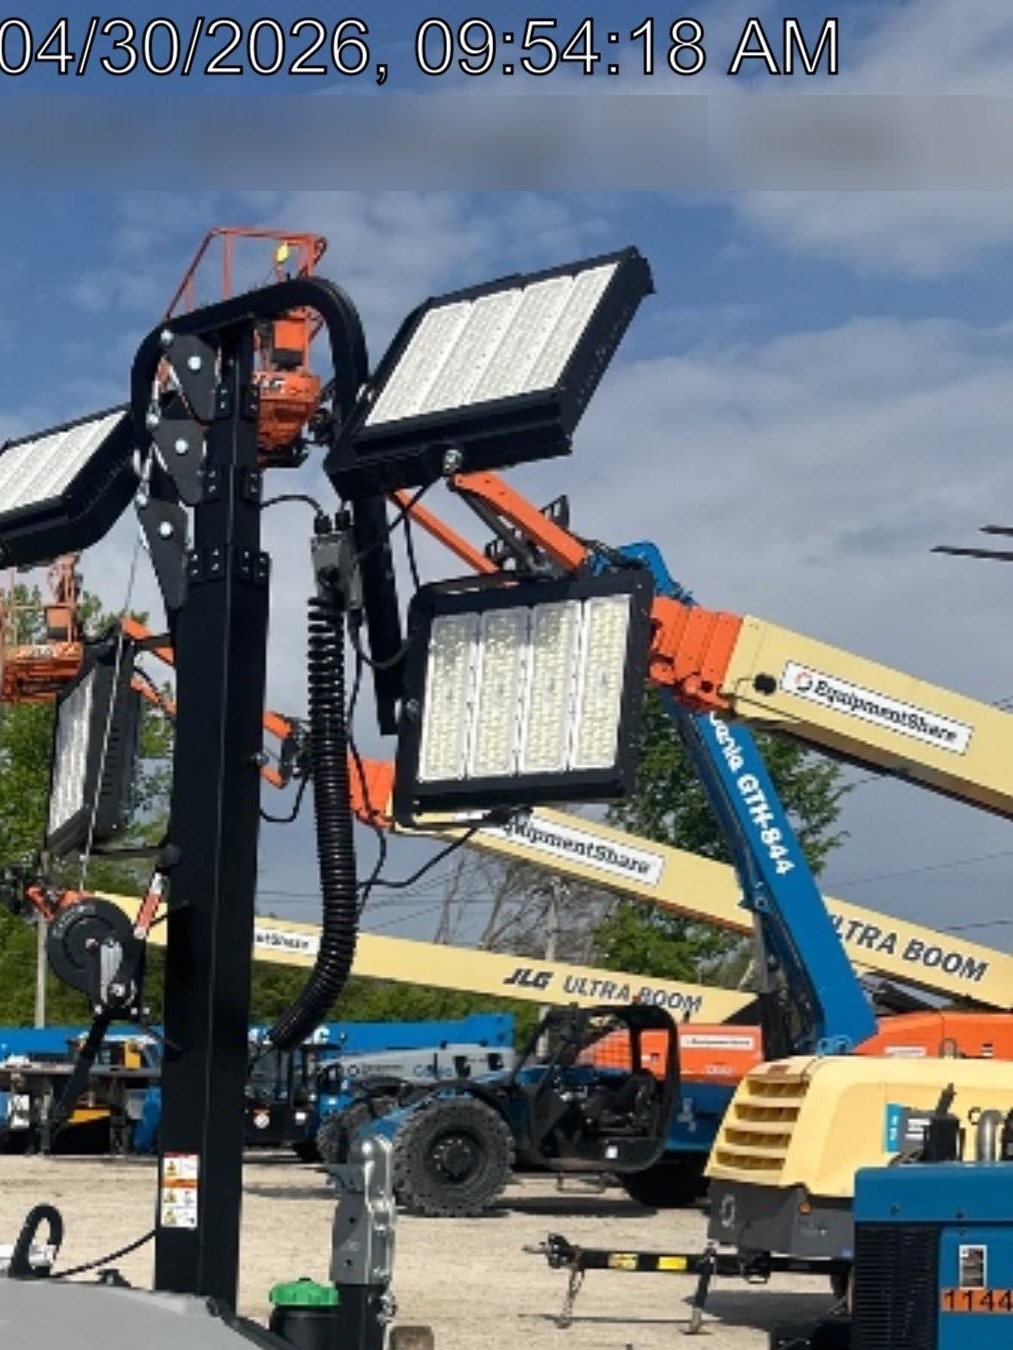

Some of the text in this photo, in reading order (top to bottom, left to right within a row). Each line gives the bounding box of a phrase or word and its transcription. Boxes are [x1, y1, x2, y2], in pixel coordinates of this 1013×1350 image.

[813, 680, 958, 742] EquipmentShare
[503, 815, 652, 875] quipmentShare
[737, 773, 796, 875] GTH-844
[503, 968, 702, 1012] JLG ULTRA BOOM
[902, 939, 989, 982] BOOM
